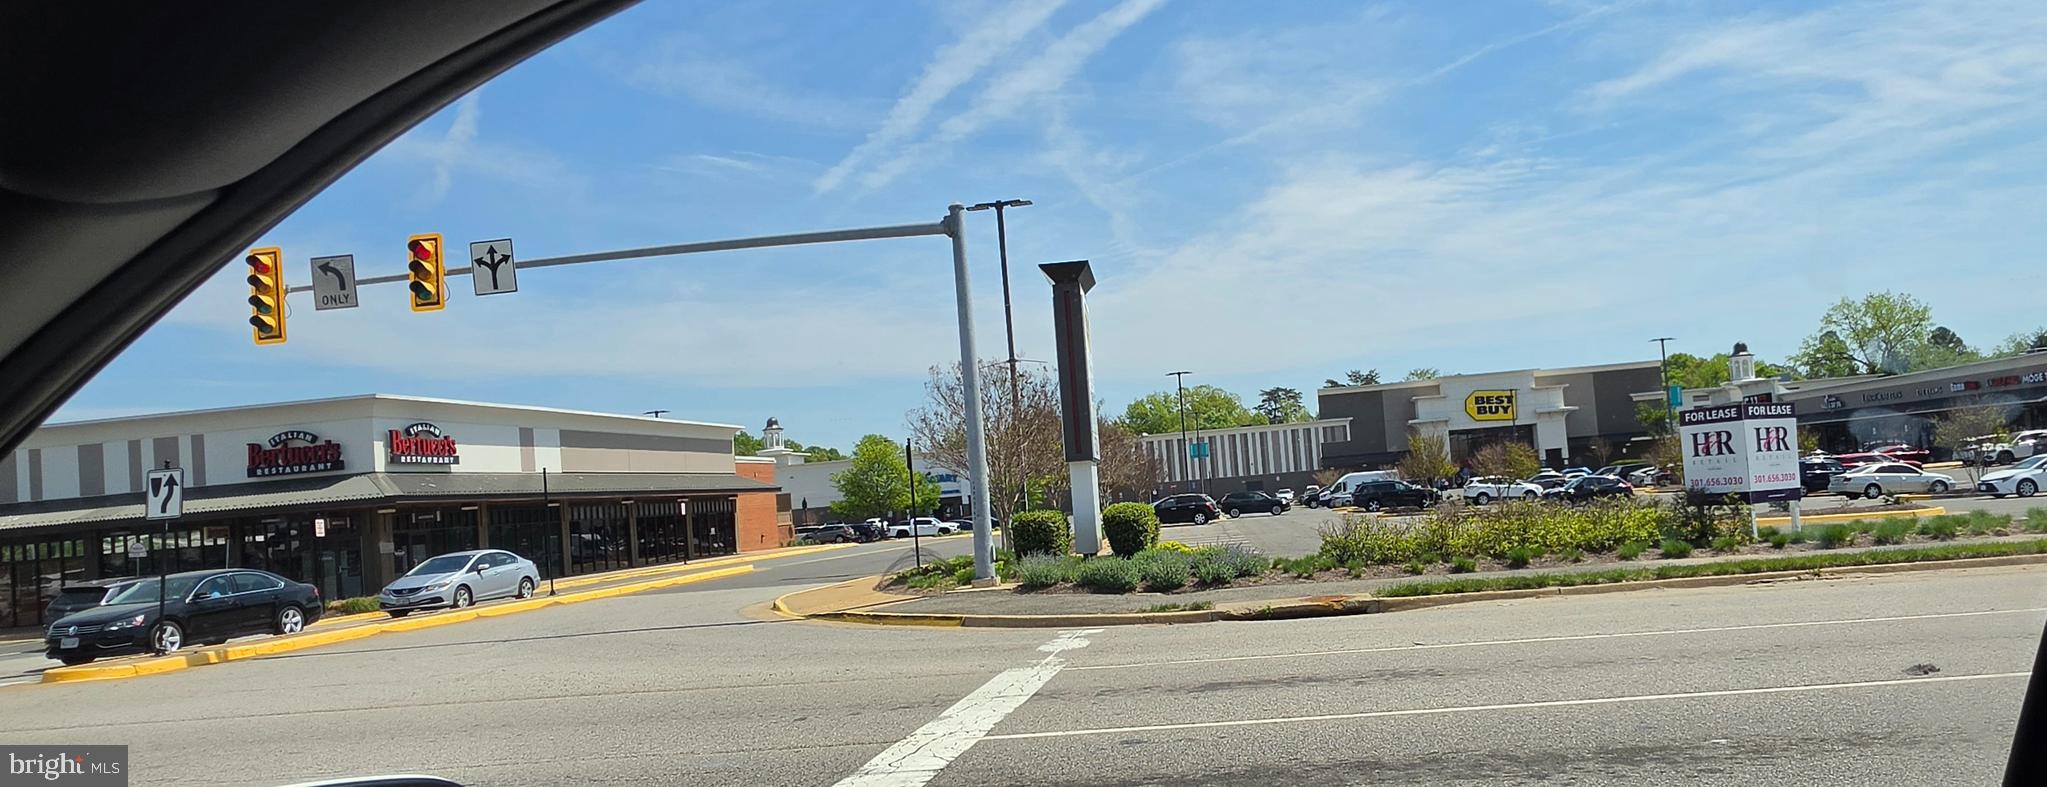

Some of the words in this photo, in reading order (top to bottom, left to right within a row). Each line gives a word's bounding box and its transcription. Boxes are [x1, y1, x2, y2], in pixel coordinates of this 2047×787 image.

[321, 293, 350, 306] ONLY
[1474, 395, 1514, 405] BEST
[1476, 405, 1511, 415] BUY
[1685, 412, 1705, 422] FOR
[1706, 407, 1738, 420] LEASE
[1748, 405, 1766, 416] FOR
[1766, 404, 1792, 416] LEASE
[409, 423, 441, 436] ITALIAN
[270, 431, 313, 446] ITALIAN
[246, 439, 342, 468] Bertucci's
[400, 455, 455, 464] RESTAURANT
[256, 462, 333, 476] RESTAURANT
[1690, 476, 1744, 488] 301.656.3030
[1754, 473, 1796, 484] 301.656.3030
